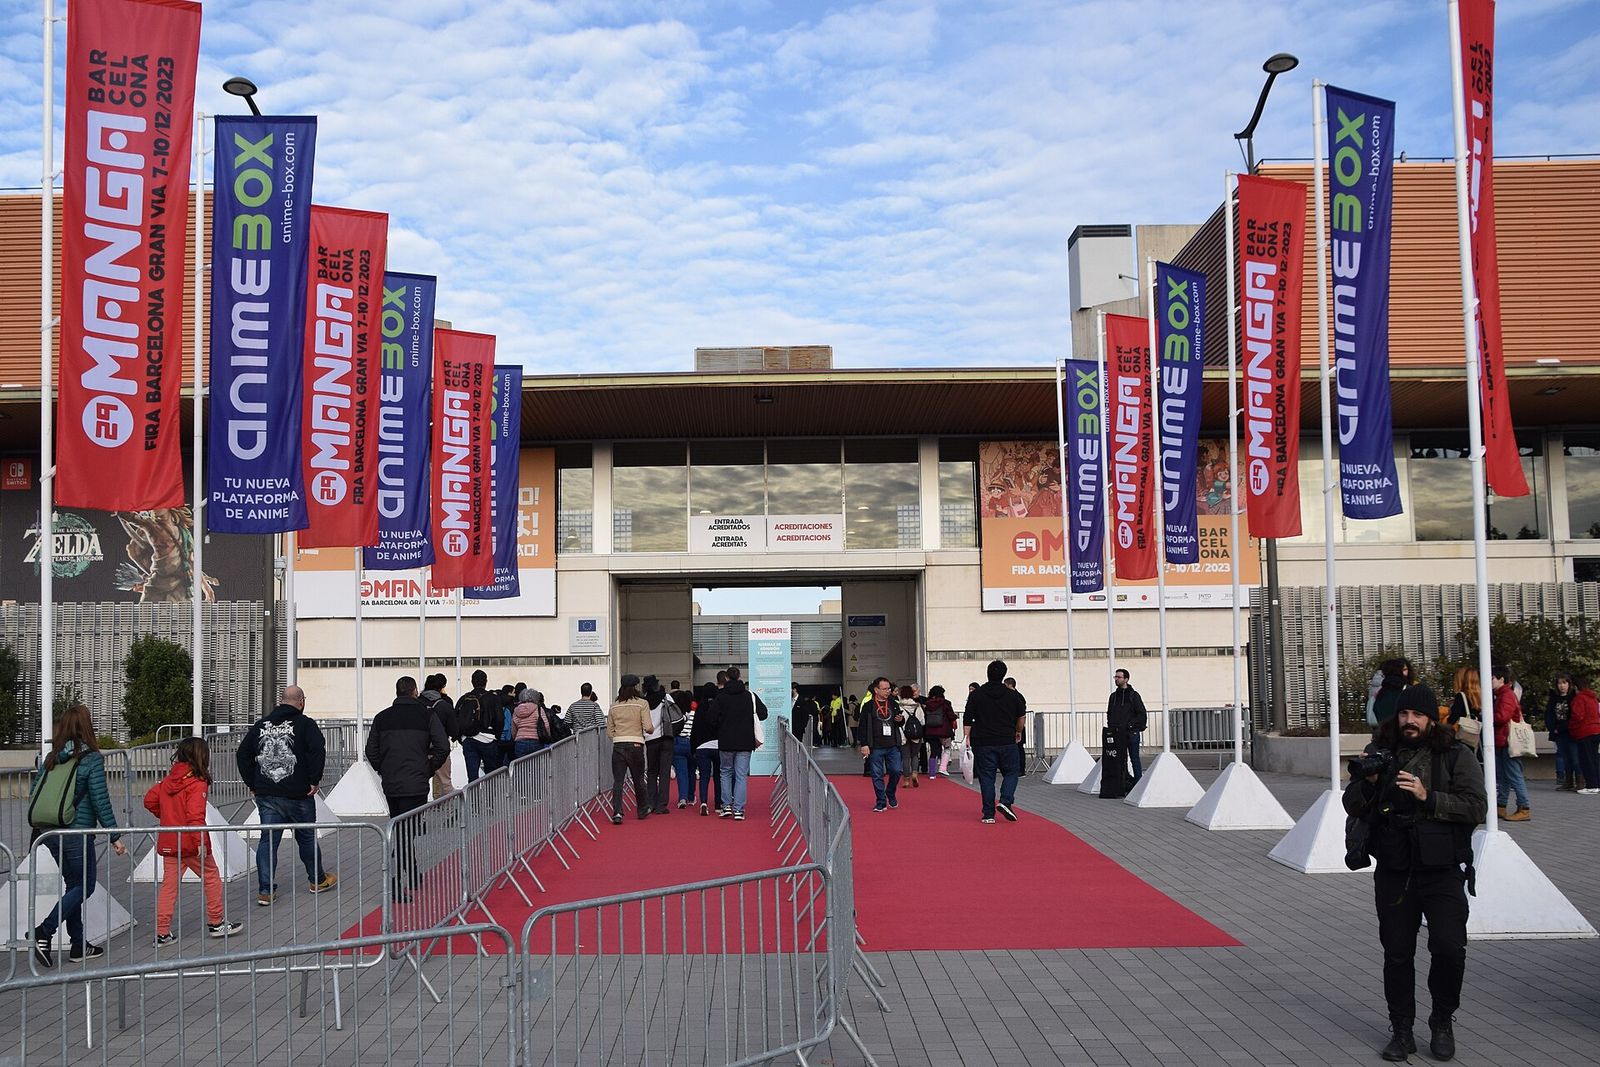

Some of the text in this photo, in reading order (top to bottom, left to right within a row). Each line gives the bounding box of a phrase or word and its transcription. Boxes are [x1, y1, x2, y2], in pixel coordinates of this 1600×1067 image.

[88, 49, 107, 103] BAR
[109, 56, 128, 106] CEL
[129, 54, 149, 108] ONA
[281, 132, 295, 243] anime-box.com
[1246, 218, 1257, 255] BAR
[1256, 222, 1267, 257] CEL
[1267, 221, 1278, 258] ONA
[144, 57, 175, 451] FIRA BARCELONA GRAN VIA 7-10/12/2023
[317, 246, 328, 279] BAR
[329, 250, 341, 281] CEL
[342, 248, 354, 283] ONA
[81, 110, 147, 441] 29 MANGA
[410, 286, 422, 367] anime-box.com
[1191, 282, 1202, 361] anime-box.com
[452, 362, 461, 387] CEL
[462, 362, 471, 388] ONA
[1123, 348, 1132, 373] CEL
[1133, 347, 1141, 373] ONA
[1246, 260, 1277, 459] MANGA
[1276, 223, 1292, 496] FIRA BARCELONA GRAN VIA 7-10/12/2023
[310, 283, 353, 500] 29 MANGA
[353, 250, 371, 504] FIRA BARCELONA GRAN VIA 7-10/12/2023
[474, 363, 483, 423] 7-10/12/2023
[502, 374, 511, 438] anime-box.com
[1142, 410, 1151, 429] VIA
[473, 426, 481, 444] VIA
[1115, 375, 1141, 521] MANGA
[1142, 433, 1151, 462] GRAN
[441, 389, 471, 530] MANGA
[473, 447, 481, 473] GRAN
[1346, 463, 1381, 475] NUEVA
[213, 490, 299, 505] PLATAFORMA
[224, 477, 291, 490] TU NUEVA
[1351, 493, 1384, 505] ANIME
[226, 507, 289, 519] DE ANIME
[473, 477, 481, 533] BARCELONA
[391, 530, 423, 539] NUEVA
[1016, 538, 1036, 552] 29
[1200, 528, 1228, 537] BAR
[1200, 539, 1227, 547] CEL
[377, 551, 422, 560] DE ANIME
[1012, 565, 1036, 575] FIRA
[1200, 549, 1230, 559] ONA
[486, 584, 510, 592] ANIME
